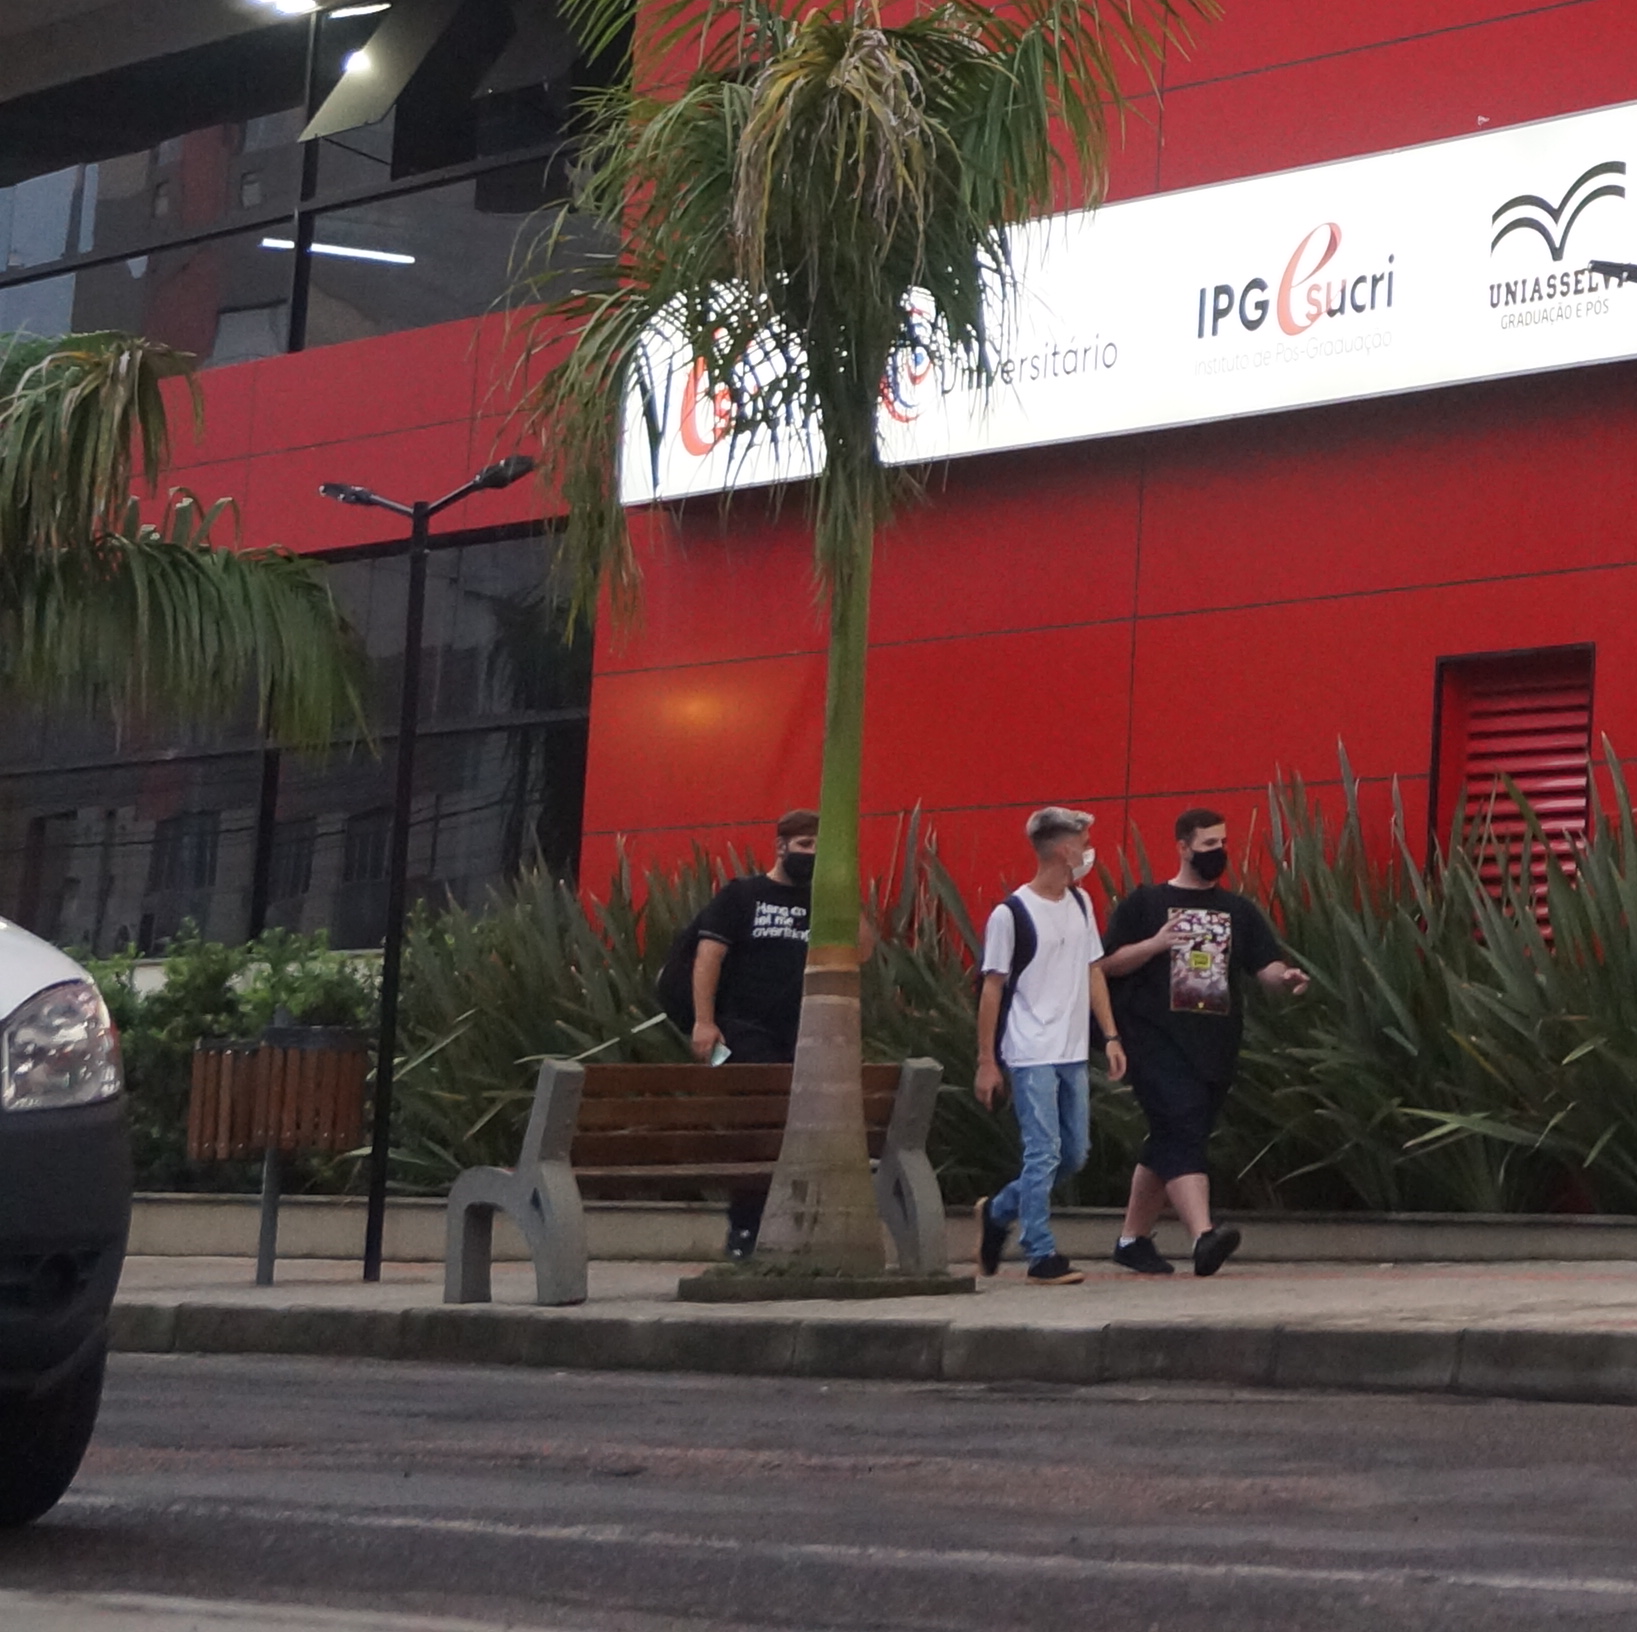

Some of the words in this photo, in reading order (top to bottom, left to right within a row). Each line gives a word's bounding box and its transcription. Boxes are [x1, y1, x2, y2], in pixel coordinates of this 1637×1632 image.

[1501, 302, 1573, 330] GRADUAÇÃO
[1576, 303, 1583, 318] E
[1586, 297, 1610, 317] PÓS
[1253, 347, 1272, 368] de
